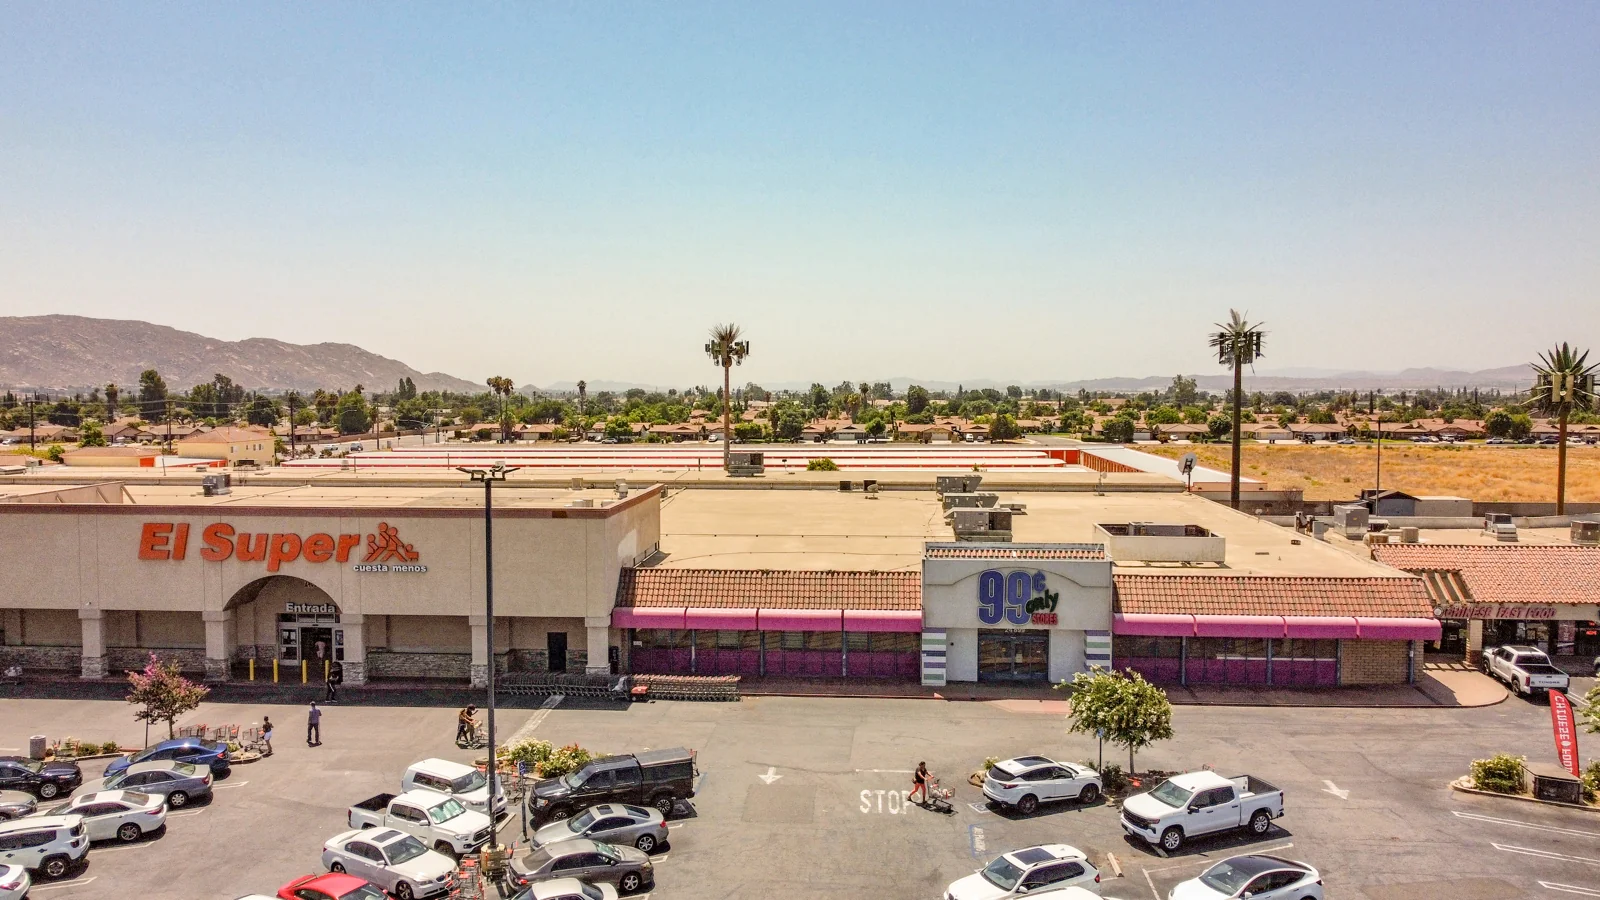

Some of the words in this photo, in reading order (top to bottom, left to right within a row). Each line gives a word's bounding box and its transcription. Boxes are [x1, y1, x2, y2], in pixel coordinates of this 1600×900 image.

[138, 522, 190, 560] El
[201, 522, 360, 572] Super
[353, 564, 388, 573] cuesta
[392, 564, 428, 573] menos
[286, 602, 336, 613] Entrada
[1025, 589, 1059, 614] only
[1496, 607, 1524, 618] FAST
[1525, 607, 1557, 618] FOOD
[1032, 613, 1059, 625] STORES
[859, 789, 920, 815] STOP
